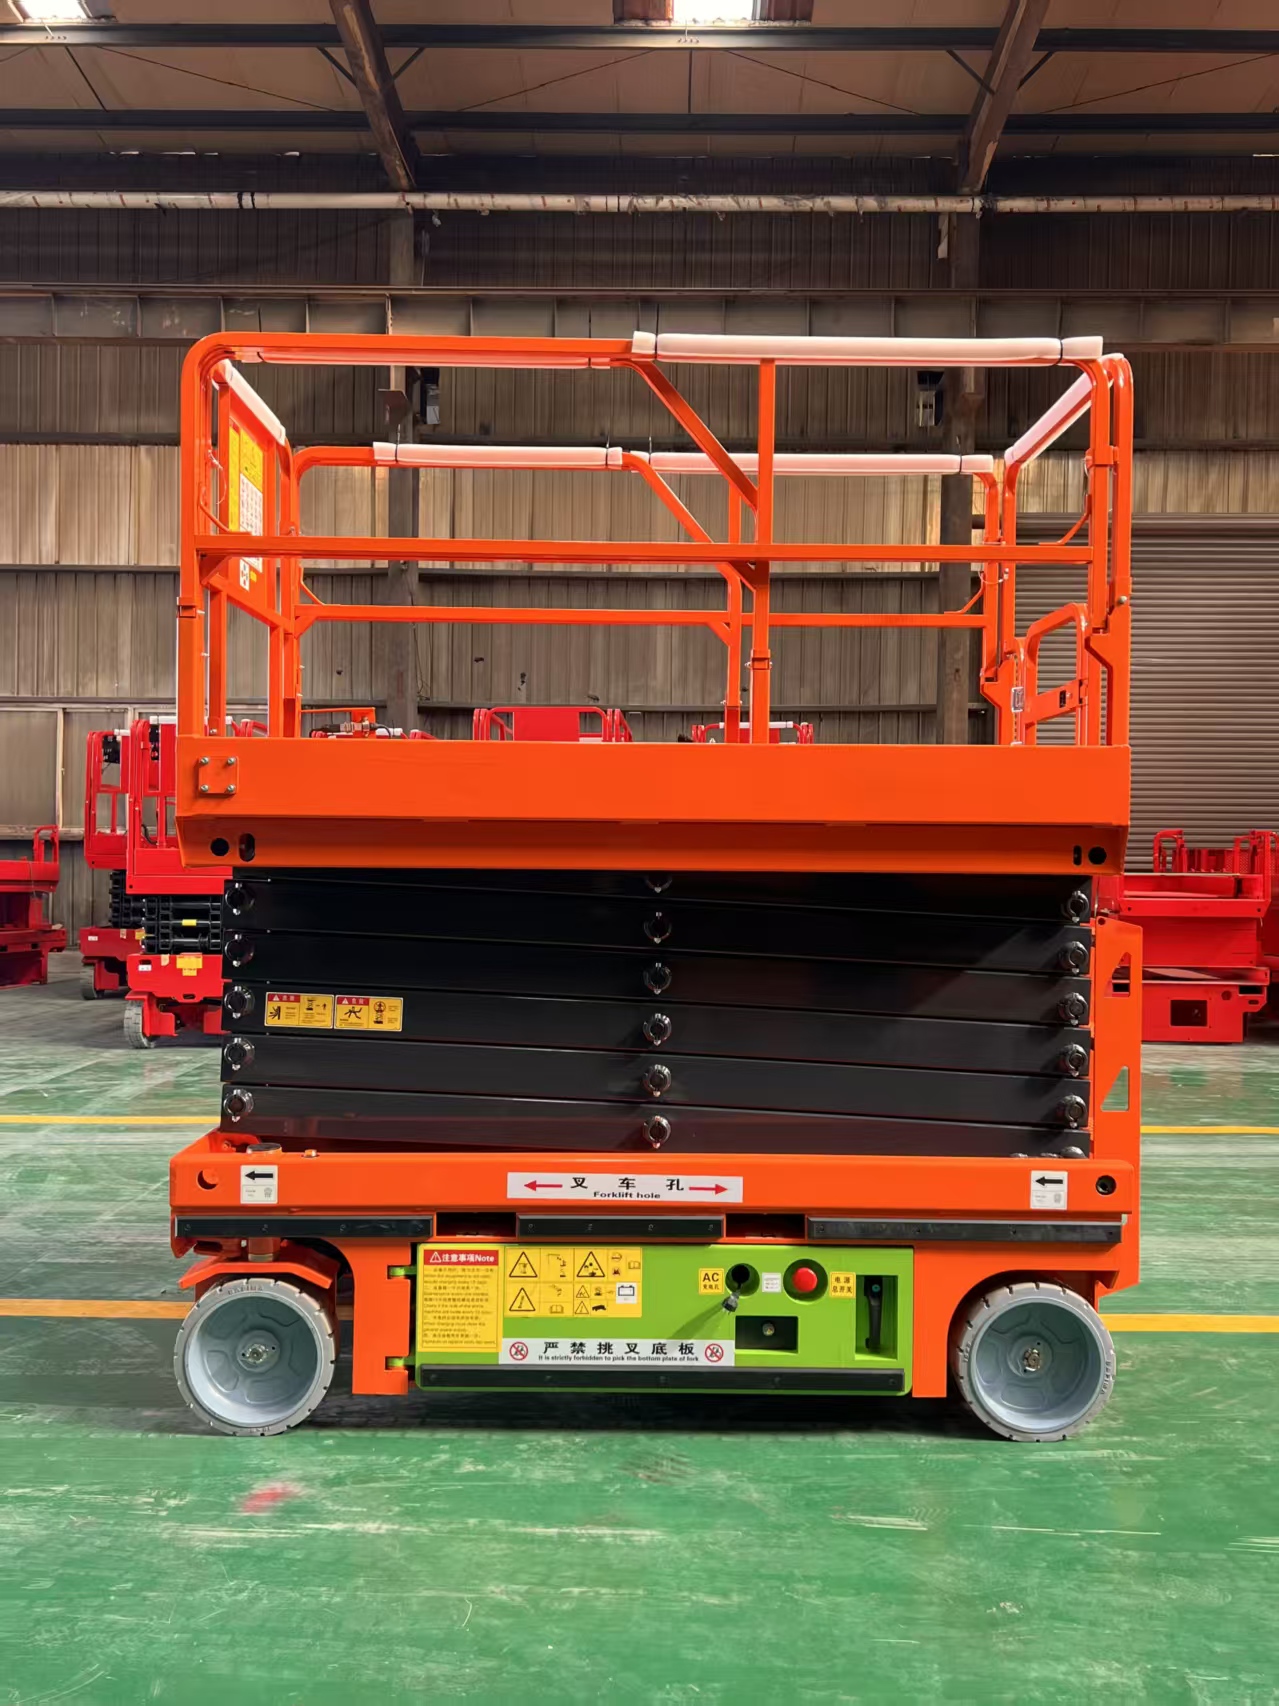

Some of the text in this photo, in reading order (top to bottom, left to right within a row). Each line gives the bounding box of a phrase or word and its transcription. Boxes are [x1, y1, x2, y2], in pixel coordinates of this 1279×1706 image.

[570, 1177, 684, 1191] 叉车孔
[593, 1191, 633, 1199] Forklift
[702, 1272, 720, 1282] AC
[832, 1285, 853, 1294] 总开关
[543, 1341, 694, 1356] 严禁挑叉底板
